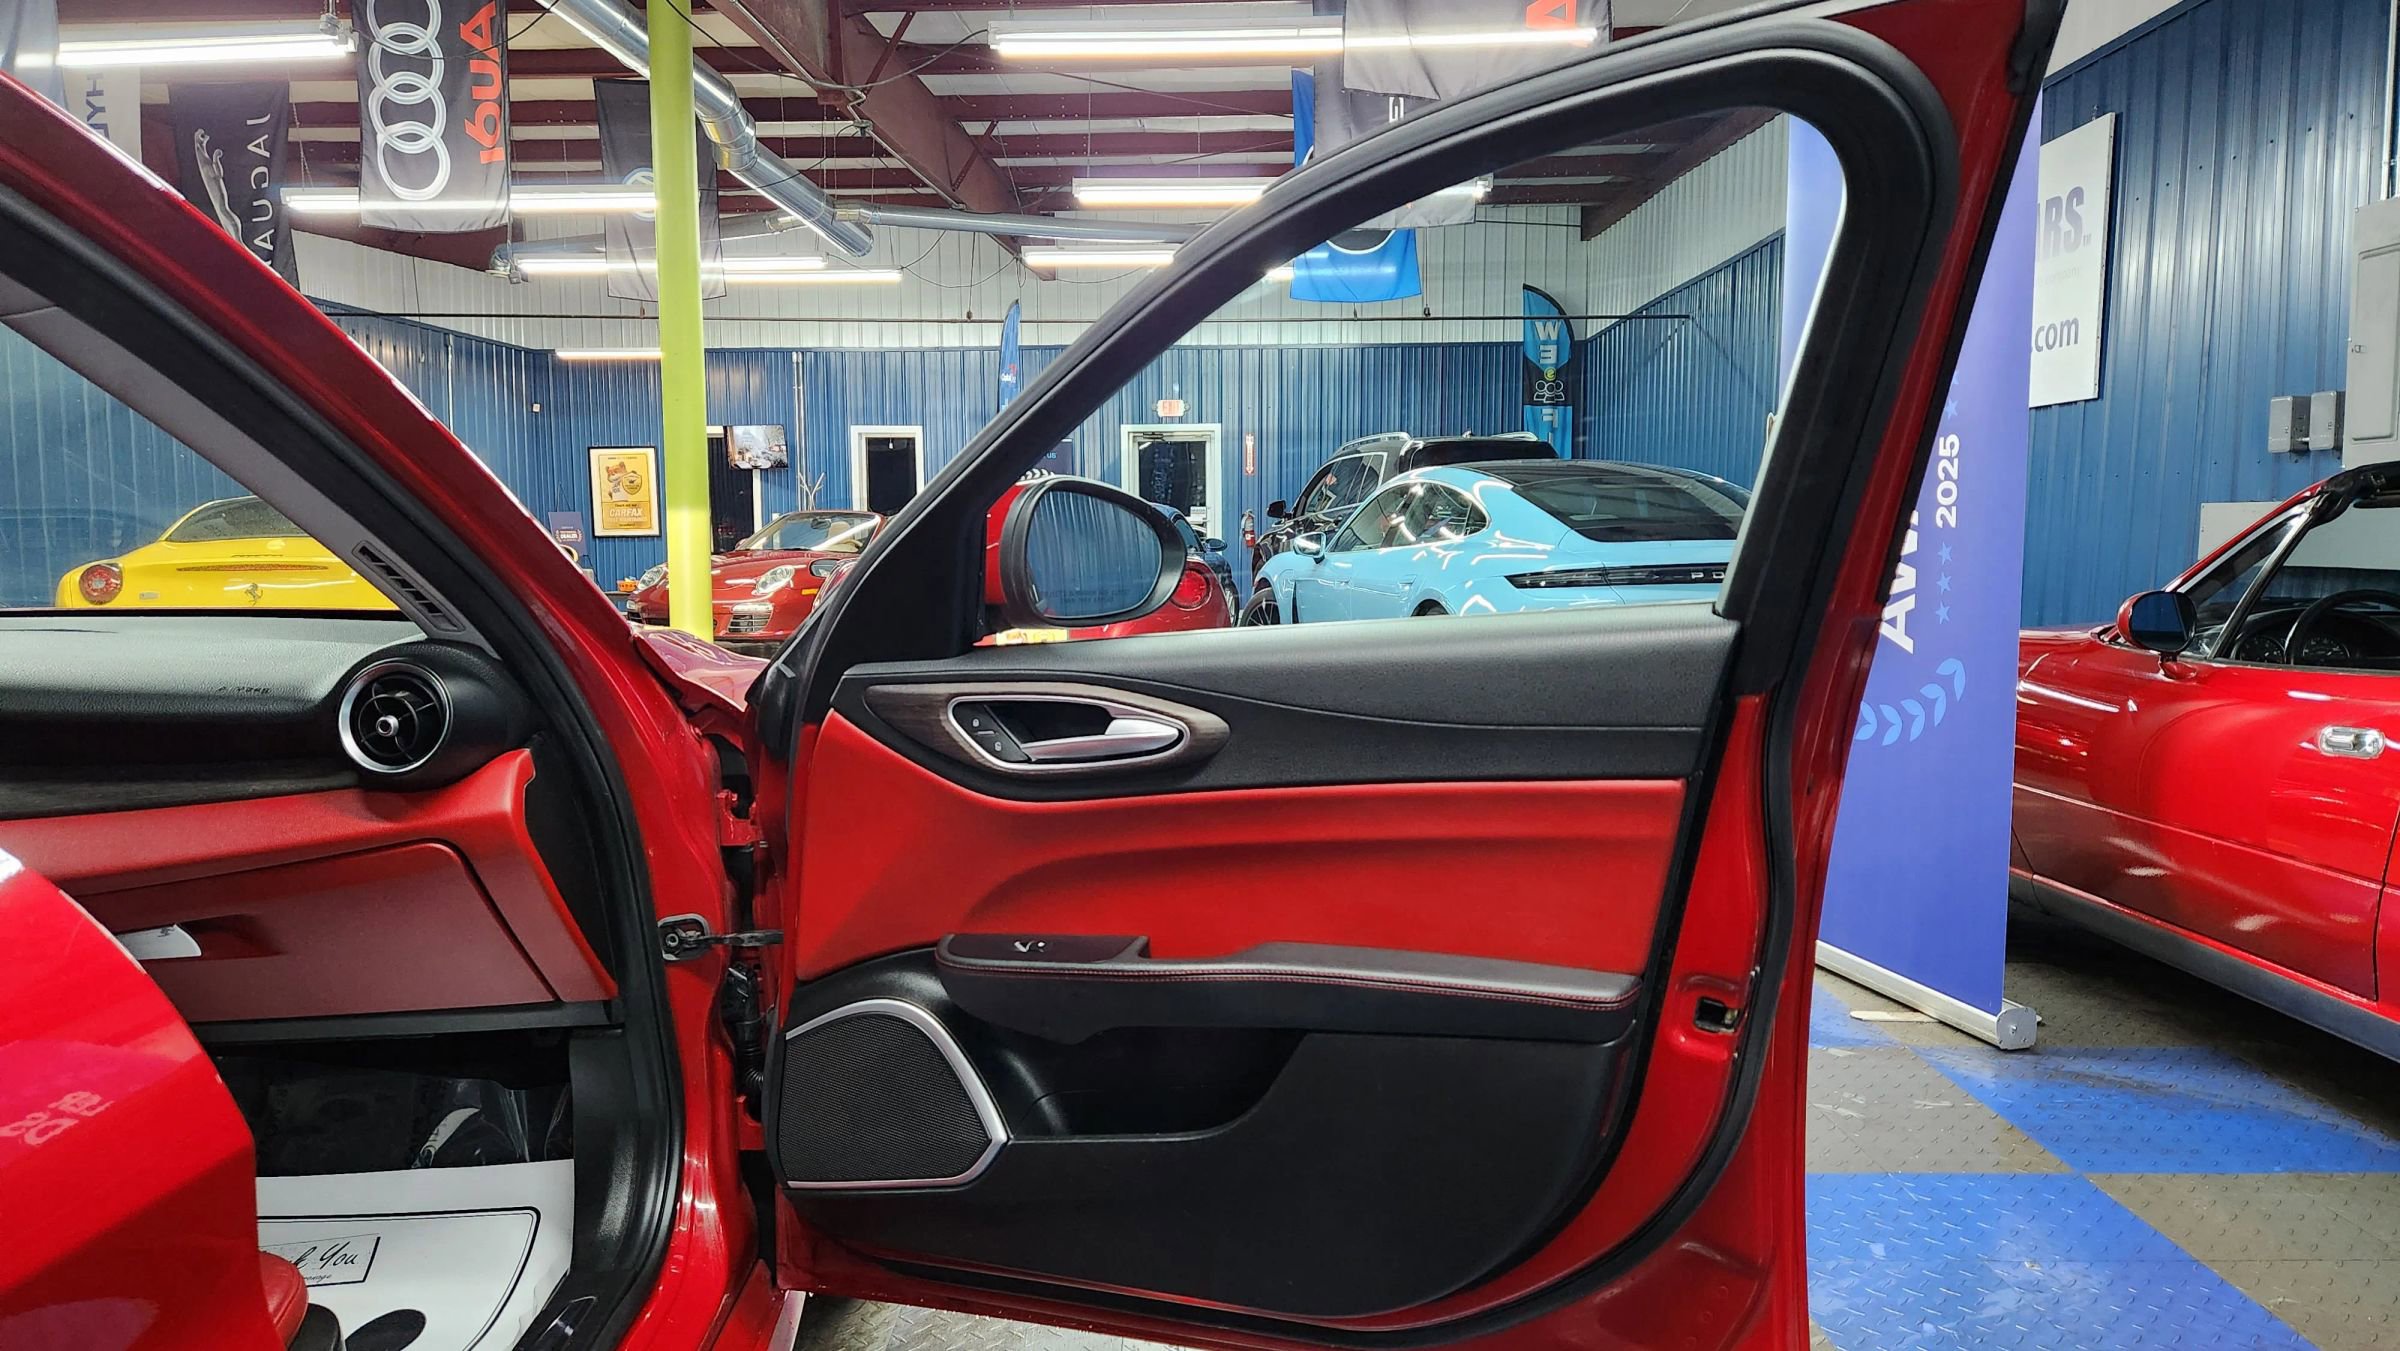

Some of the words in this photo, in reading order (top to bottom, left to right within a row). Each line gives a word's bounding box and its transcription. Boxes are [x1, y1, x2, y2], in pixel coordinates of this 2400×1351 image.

[1935, 433, 1960, 530] 2025
[609, 507, 643, 518] CARFAX
[317, 1240, 358, 1270] You
